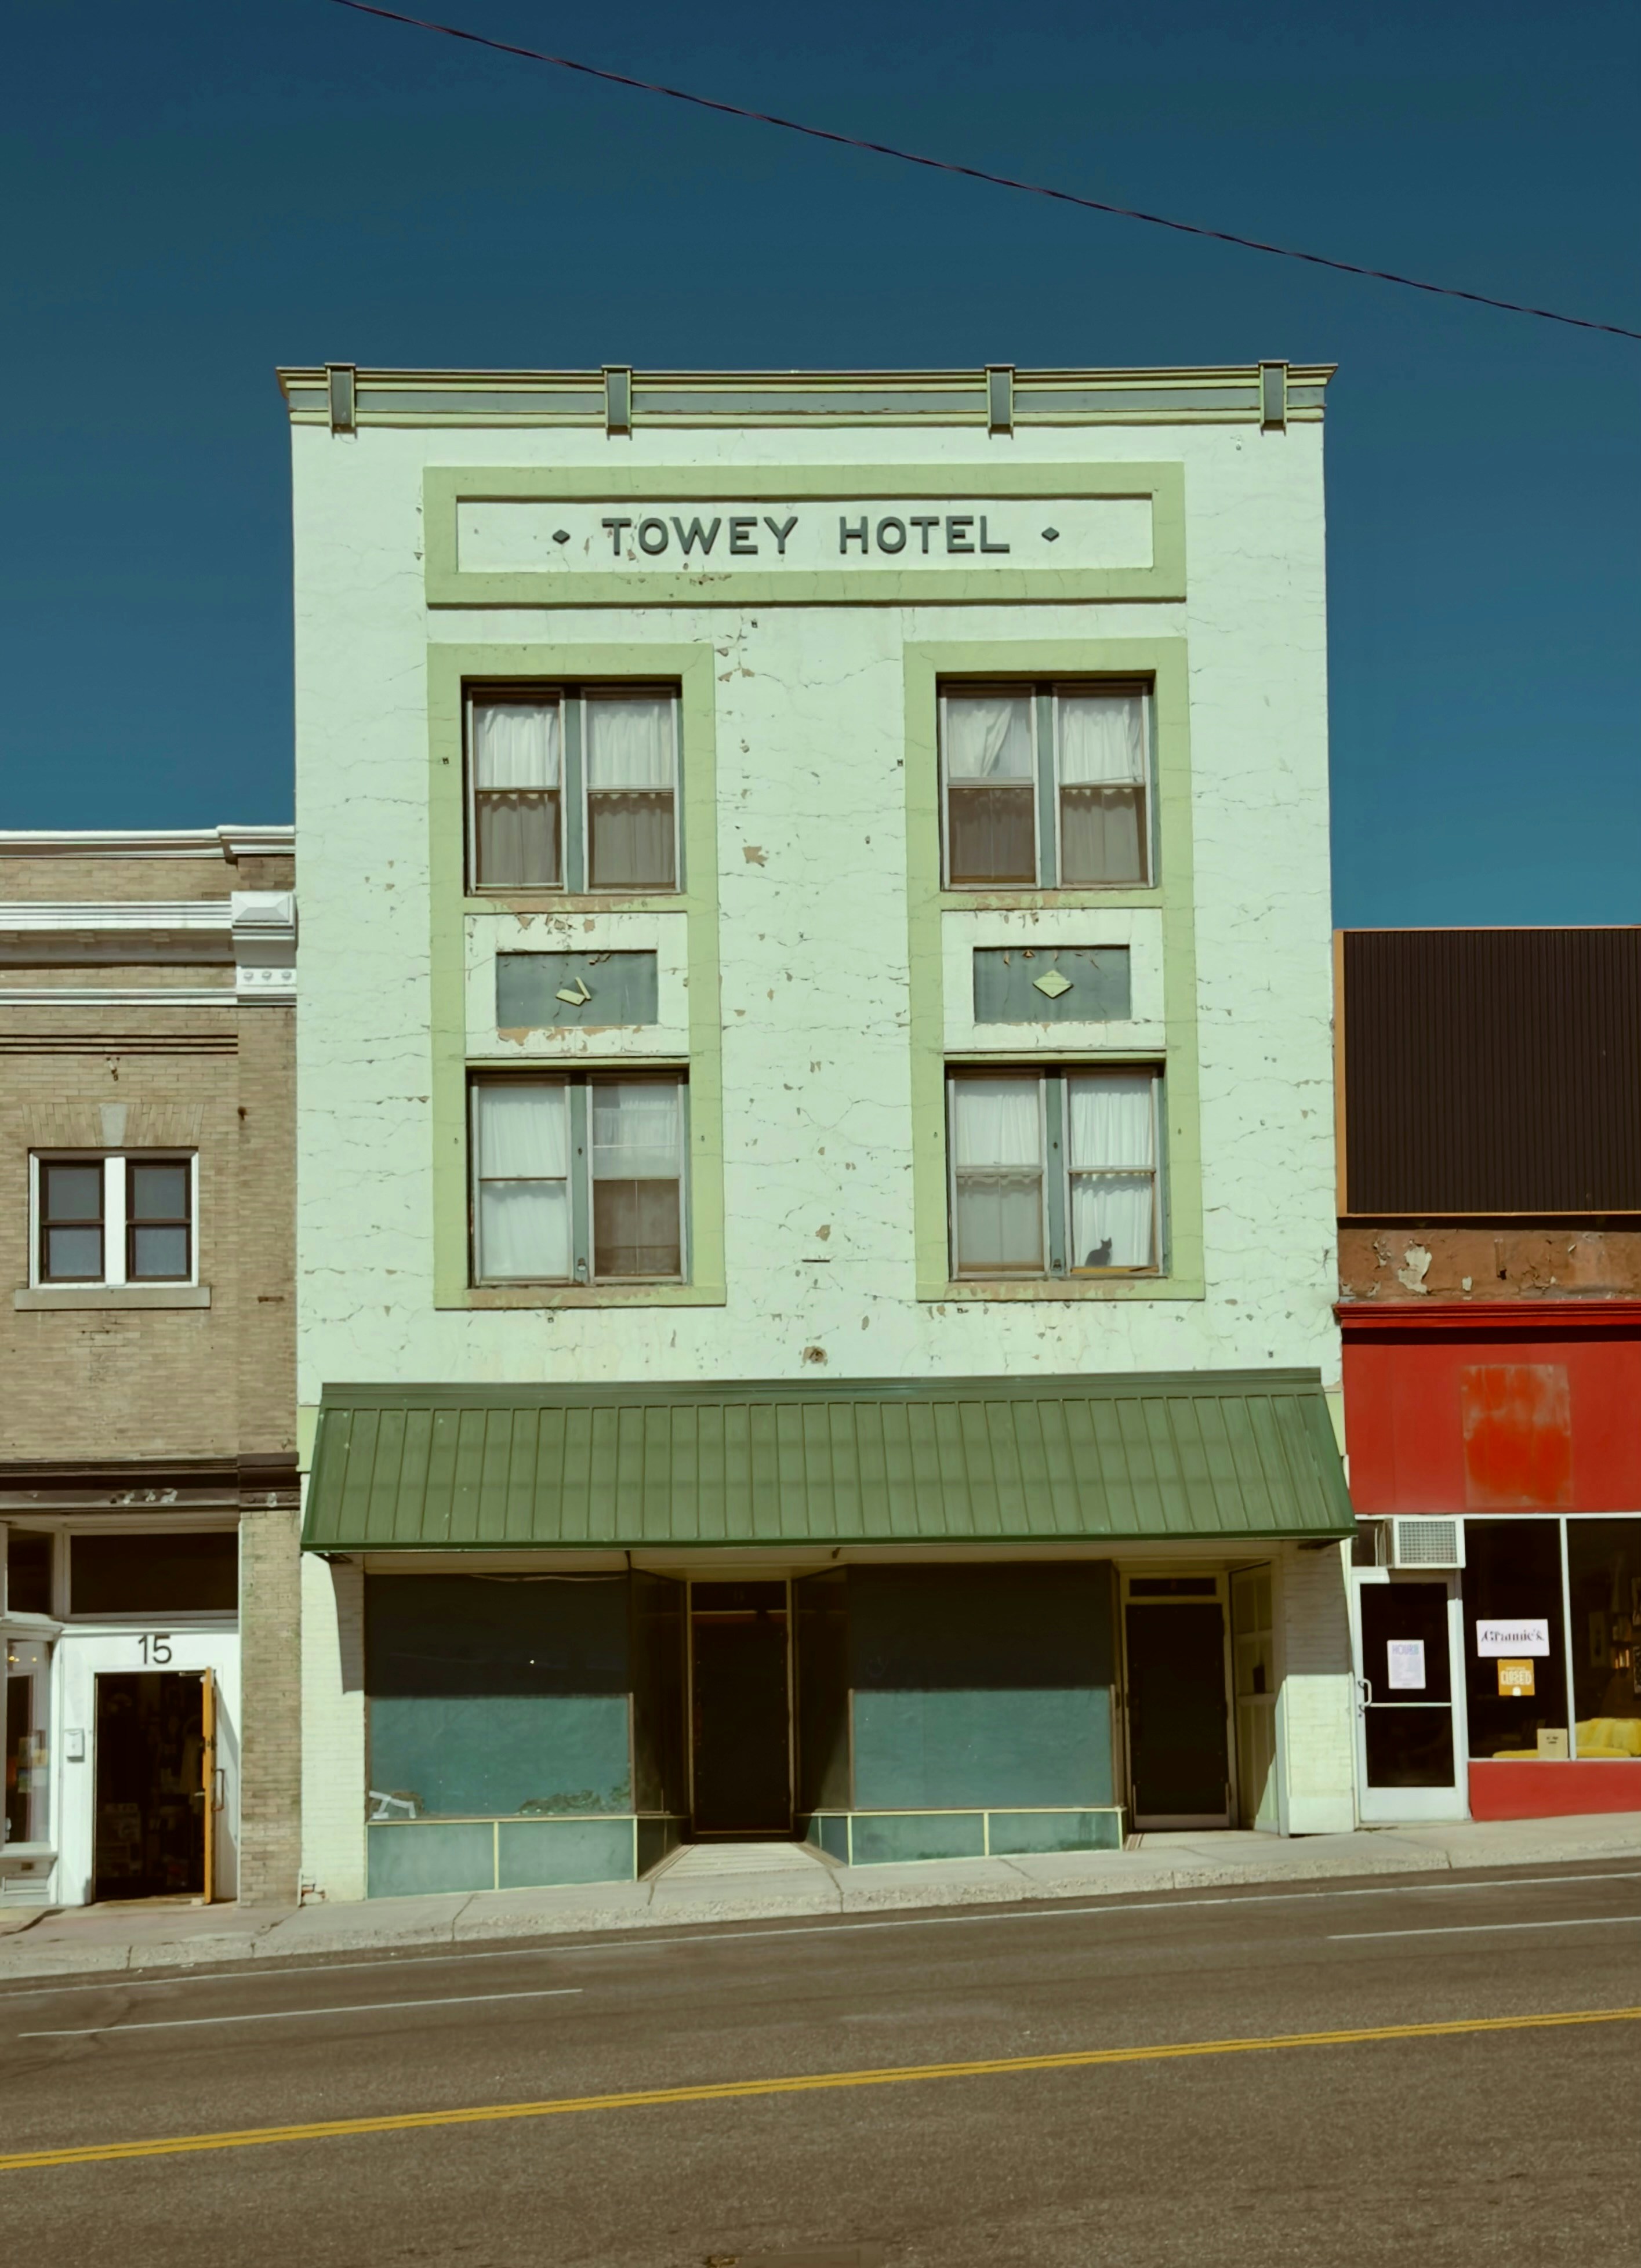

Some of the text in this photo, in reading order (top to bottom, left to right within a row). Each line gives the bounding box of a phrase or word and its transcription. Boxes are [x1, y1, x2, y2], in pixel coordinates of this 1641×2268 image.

[601, 515, 1010, 555] TOWEY HOTEL
[138, 1633, 172, 1664] 15
